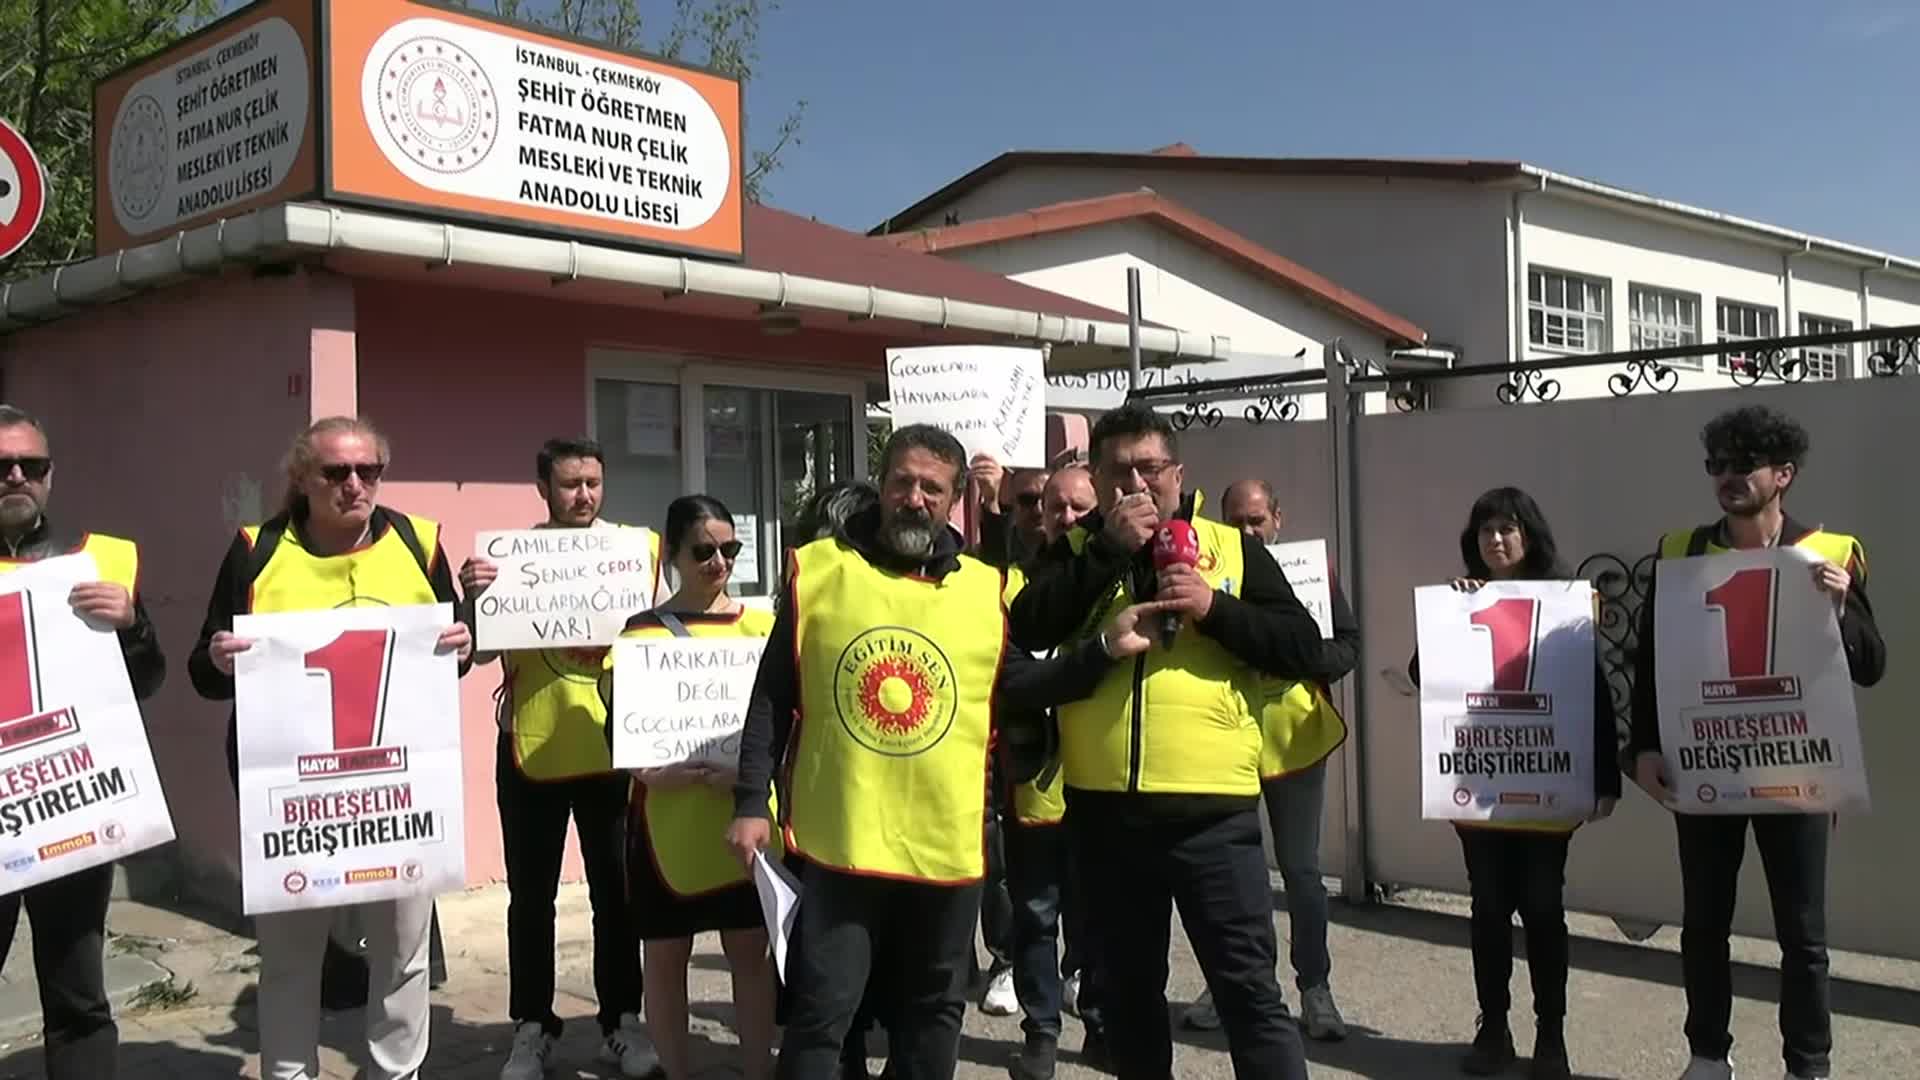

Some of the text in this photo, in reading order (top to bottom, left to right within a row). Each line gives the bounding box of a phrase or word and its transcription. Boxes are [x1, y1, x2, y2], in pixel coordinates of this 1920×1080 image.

[177, 56, 278, 121] ŞEHİT ÖĞRETMEN
[516, 44, 582, 77] İSTANBUL
[593, 67, 661, 95] ÇEKMEKÖY
[177, 88, 279, 150] FATMA NUR ÇELİK
[518, 78, 576, 107] ŞEHİT
[581, 88, 687, 133] ÖĞRETMEN
[177, 122, 289, 184] MESLEKİ VE TEKNİK
[518, 111, 688, 165] FATMA NUR ÇELİK
[177, 161, 273, 217] ANADOLU LİSESİ
[519, 145, 703, 199] MESLEKİ VE TEKNİK
[519, 180, 679, 225] ANADOLU LİSESİ
[1470, 598, 1535, 691] 1
[1705, 568, 1773, 678] 1
[304, 629, 389, 751] 1
[1439, 748, 1571, 779] DEĞİŞTİRELİM
[1679, 738, 1833, 773] DEĞİŞTİRELİM
[263, 811, 434, 860] DEĞİŞTİRELİM
